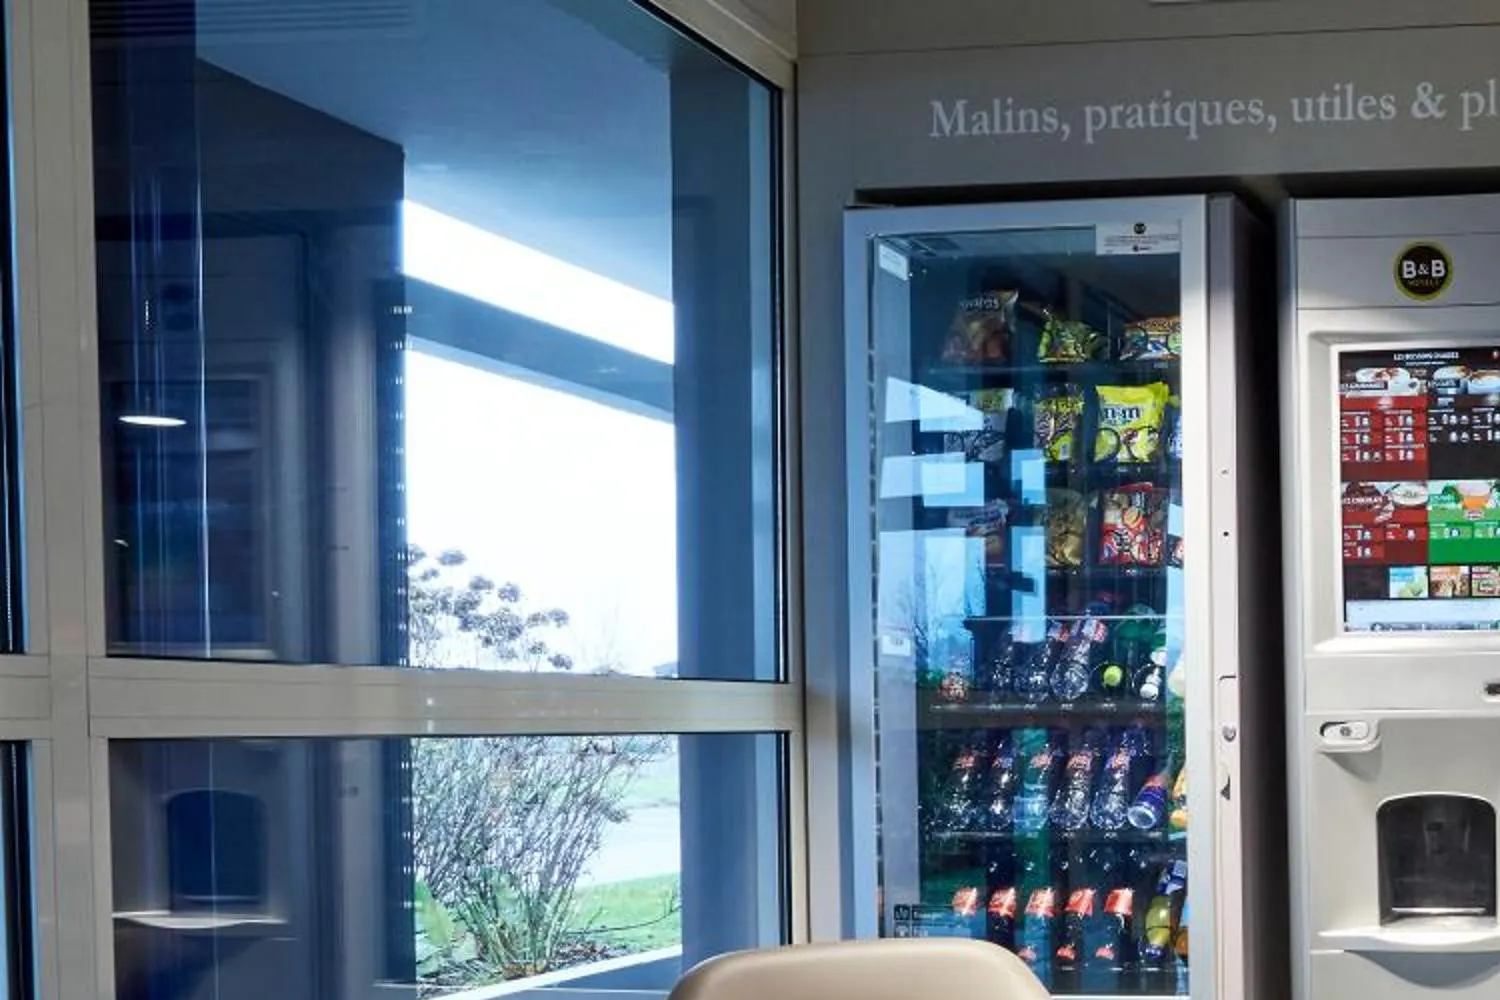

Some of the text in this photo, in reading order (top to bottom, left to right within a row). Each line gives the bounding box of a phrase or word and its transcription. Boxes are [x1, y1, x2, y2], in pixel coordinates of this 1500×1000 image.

[929, 97, 1070, 142] Malins,
[1084, 91, 1277, 144] pratiques,
[1290, 82, 1397, 123] utiles
[1410, 81, 1447, 120] &
